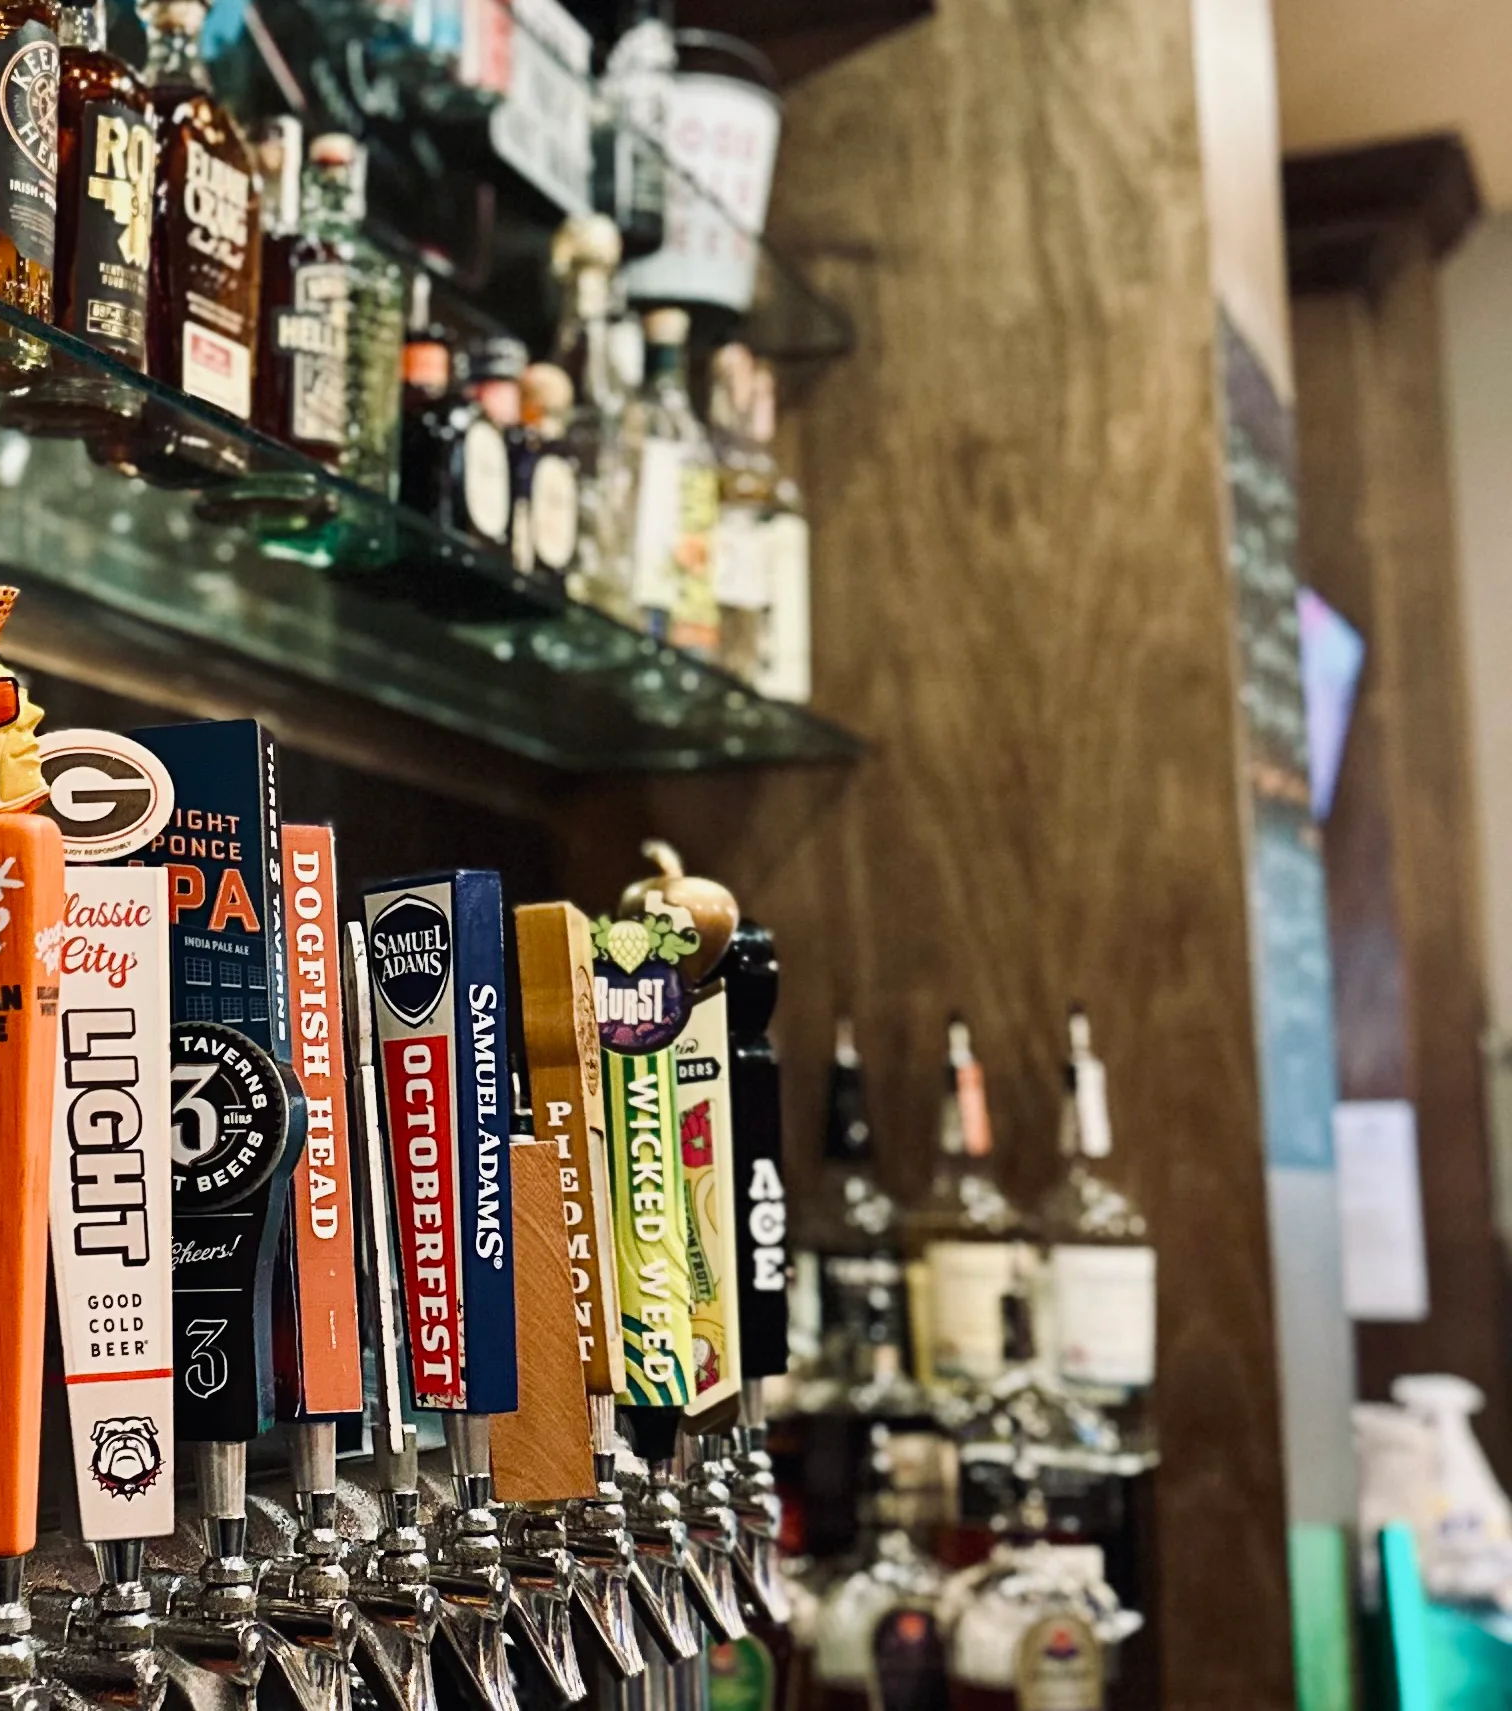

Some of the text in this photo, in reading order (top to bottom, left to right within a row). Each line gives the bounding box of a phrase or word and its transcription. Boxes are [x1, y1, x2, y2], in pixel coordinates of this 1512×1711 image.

[9, 178, 38, 198] IRISH
[166, 808, 240, 835] IGHT
[267, 742, 278, 851] THREE
[151, 834, 242, 862] PONCE
[169, 862, 261, 934] PA
[59, 935, 139, 989] City
[184, 935, 250, 956] INDIA PALE ALE
[272, 893, 286, 1041] TAVERNS
[373, 924, 448, 959] SAMUEL
[381, 951, 443, 984] ADAMS
[593, 975, 665, 1026] BURST
[179, 1036, 269, 1110] TAVERNS
[292, 850, 339, 1241] DOGFISH HEAD
[62, 1007, 151, 1268] LIGHT
[469, 983, 505, 1262] SAMUEL ADAMS
[196, 1130, 264, 1193] BEERS
[402, 1044, 454, 1389] OCTOBERFEST
[545, 1101, 596, 1362] PIEDMONT
[626, 1073, 675, 1385] WICKED WEED
[748, 1158, 785, 1292] ACE
[88, 1292, 143, 1311] GOOD
[89, 1315, 144, 1335] COLD
[90, 1340, 146, 1358] BEER
[185, 1318, 229, 1400] 3
